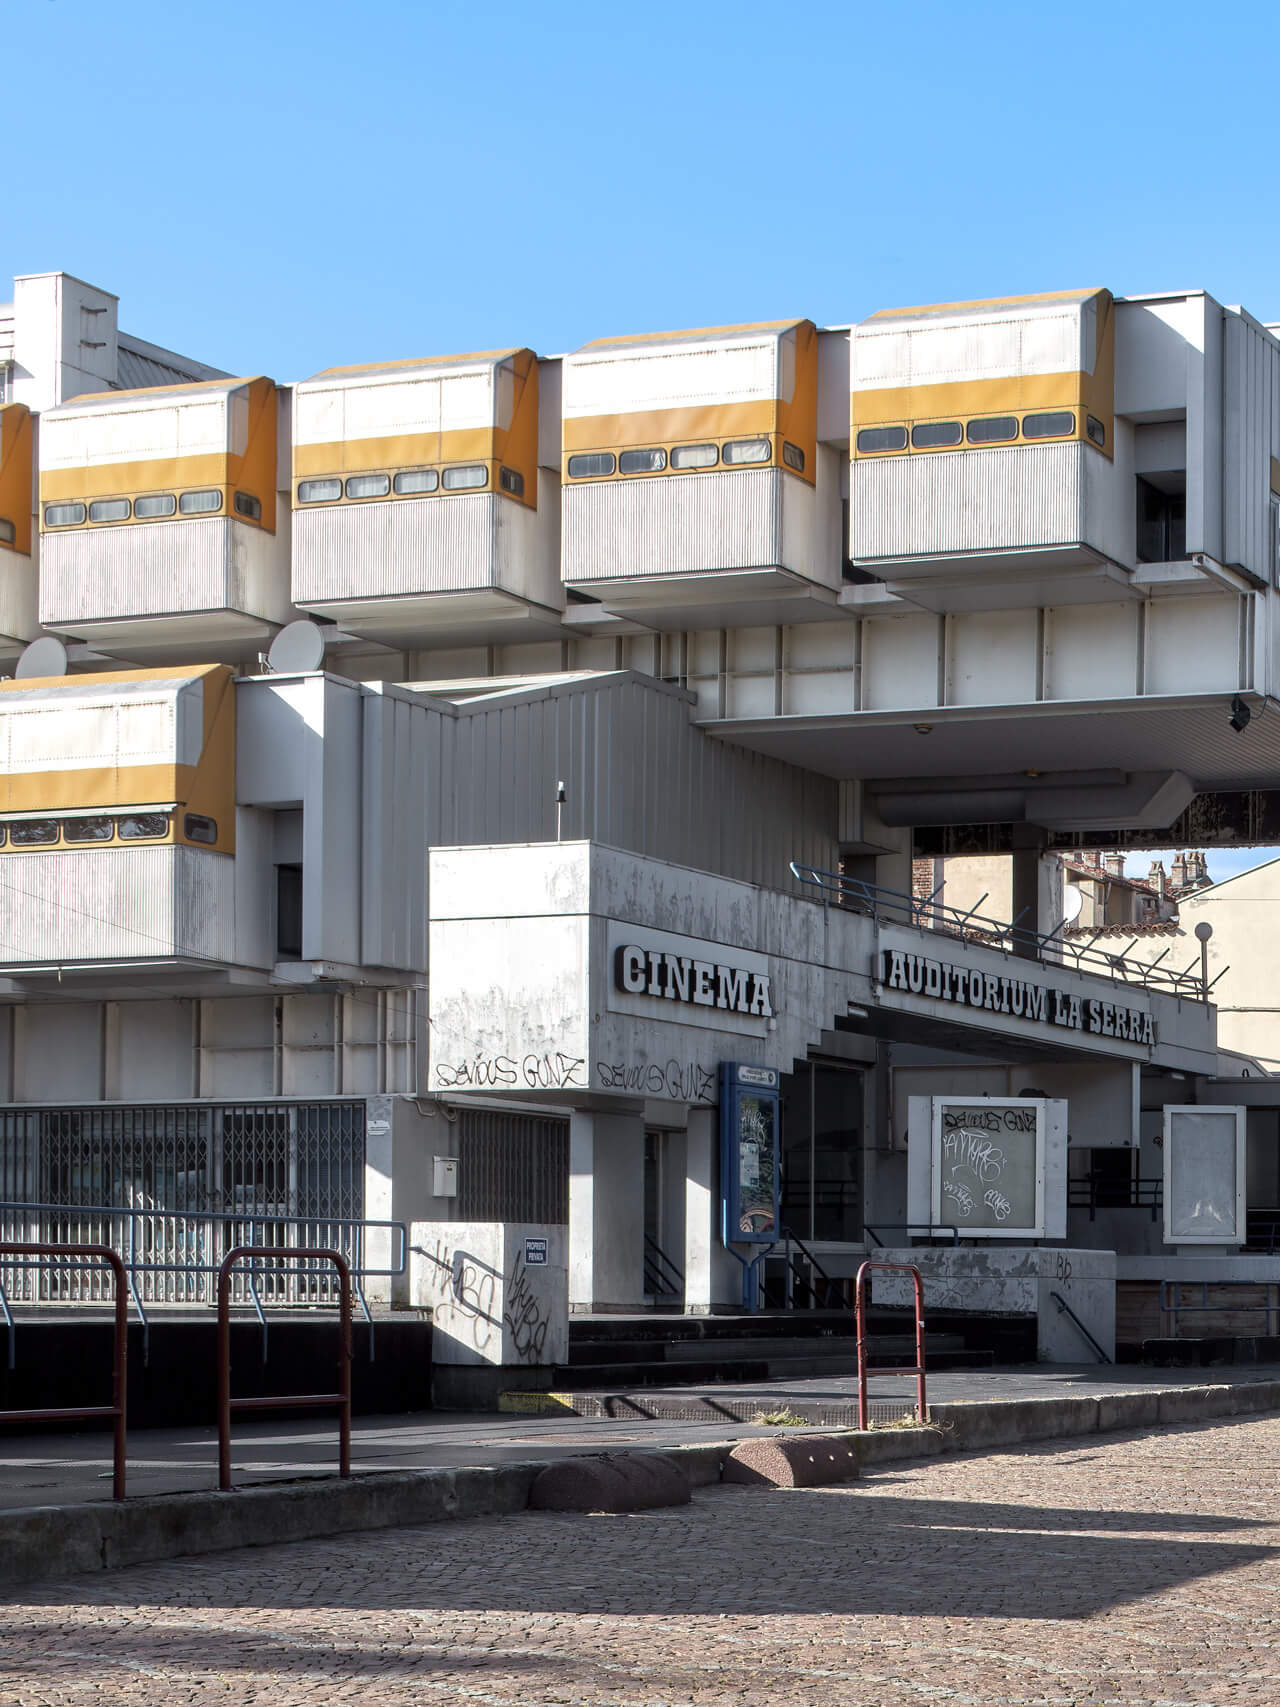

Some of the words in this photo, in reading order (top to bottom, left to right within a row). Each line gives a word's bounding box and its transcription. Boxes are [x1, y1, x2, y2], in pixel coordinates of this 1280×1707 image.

[615, 944, 772, 1017] CINEMA
[886, 949, 1048, 1022] AUDITORIUM
[1053, 988, 1082, 1030] LA
[1087, 998, 1156, 1045] SERRA
